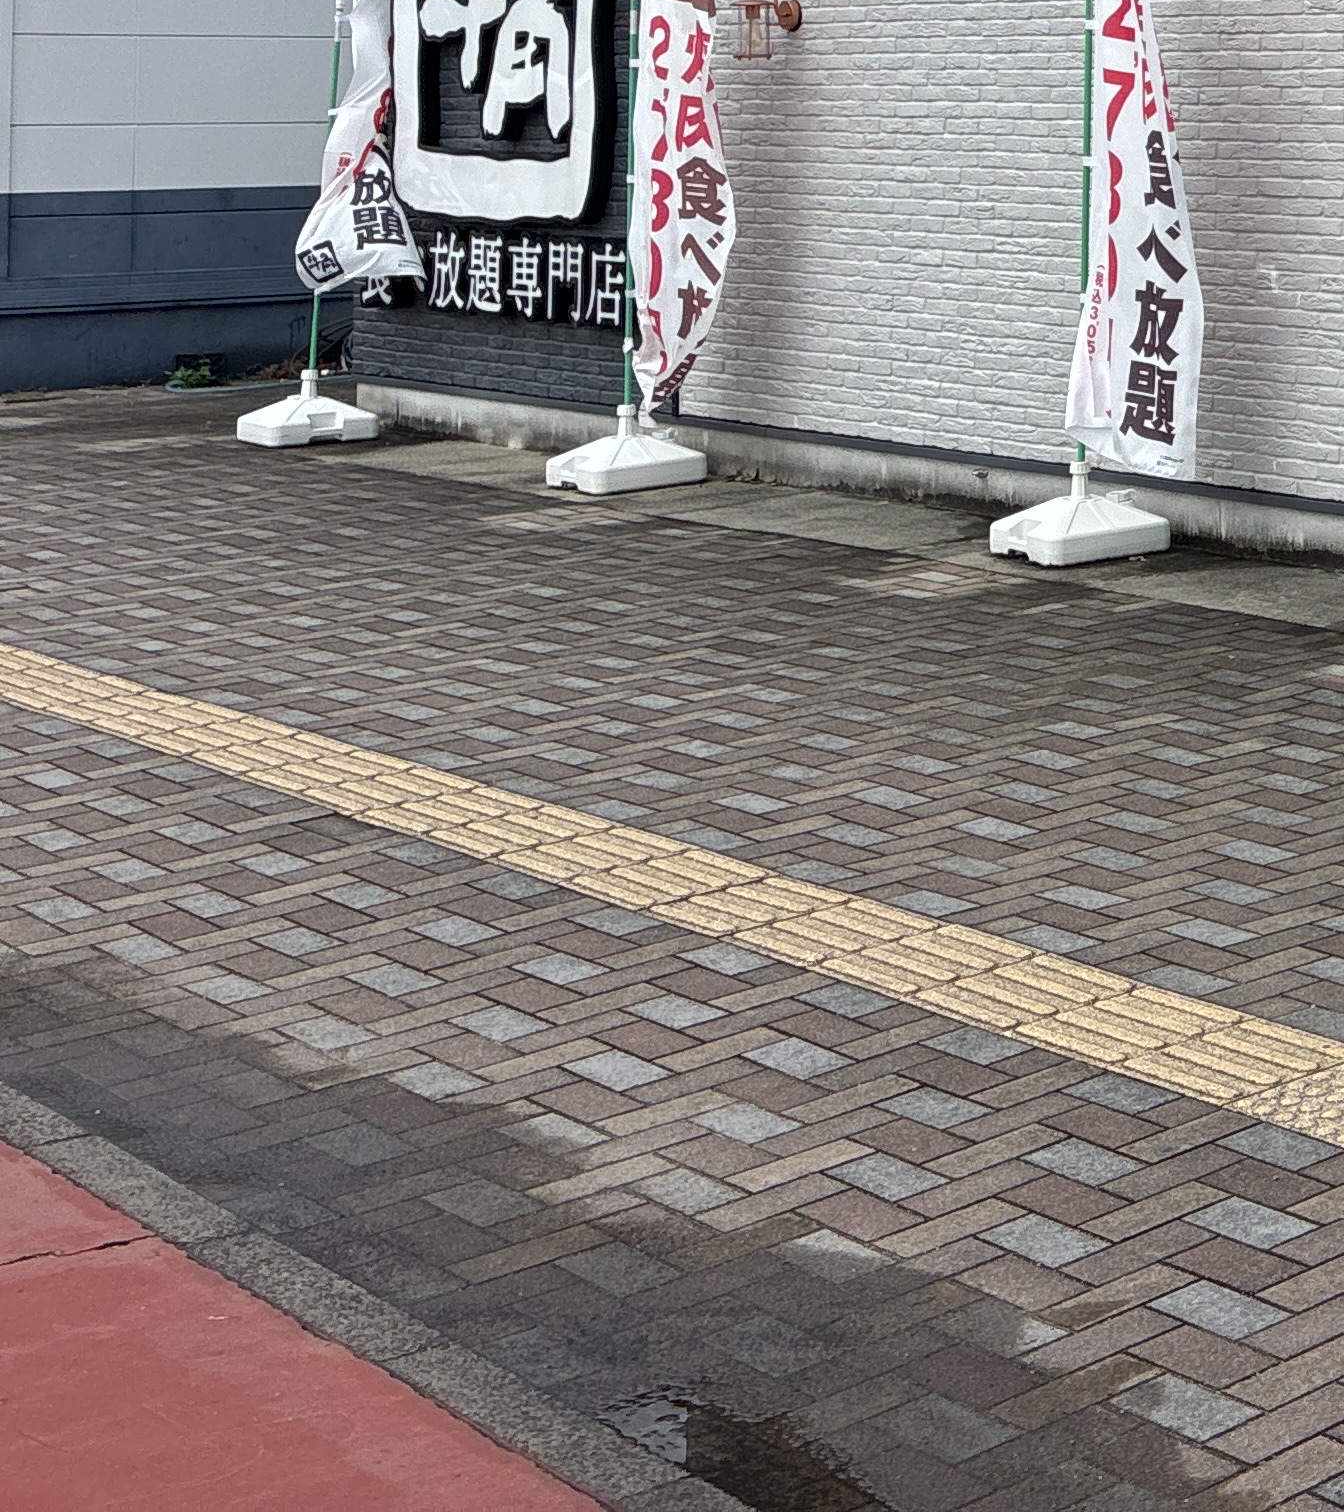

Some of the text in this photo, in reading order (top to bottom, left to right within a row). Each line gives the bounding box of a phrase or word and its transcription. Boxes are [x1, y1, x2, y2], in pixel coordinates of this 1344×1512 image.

[361, 230, 626, 326] 放題専門店
